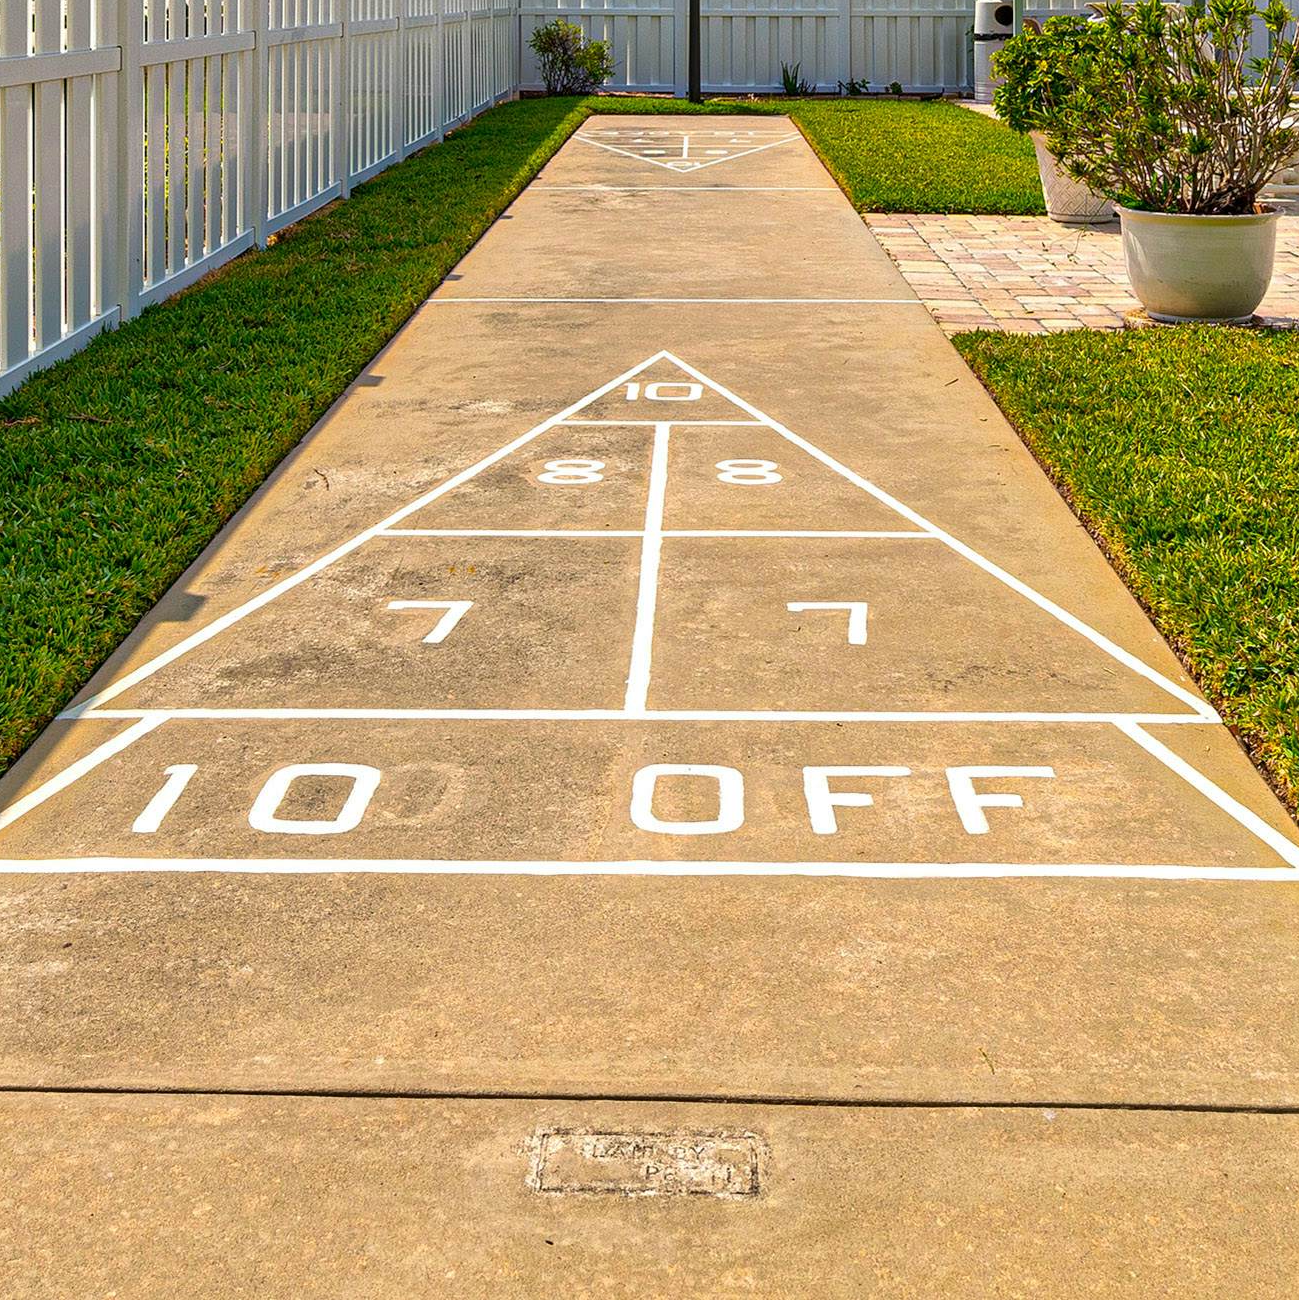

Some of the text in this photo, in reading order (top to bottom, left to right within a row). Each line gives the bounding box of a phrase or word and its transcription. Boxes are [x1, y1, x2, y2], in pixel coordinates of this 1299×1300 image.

[624, 382, 704, 401] 10
[537, 458, 606, 485] 8
[715, 459, 783, 485] 8
[386, 600, 474, 644] 7
[786, 601, 868, 645] 7
[132, 762, 1056, 835] 10 OFF
